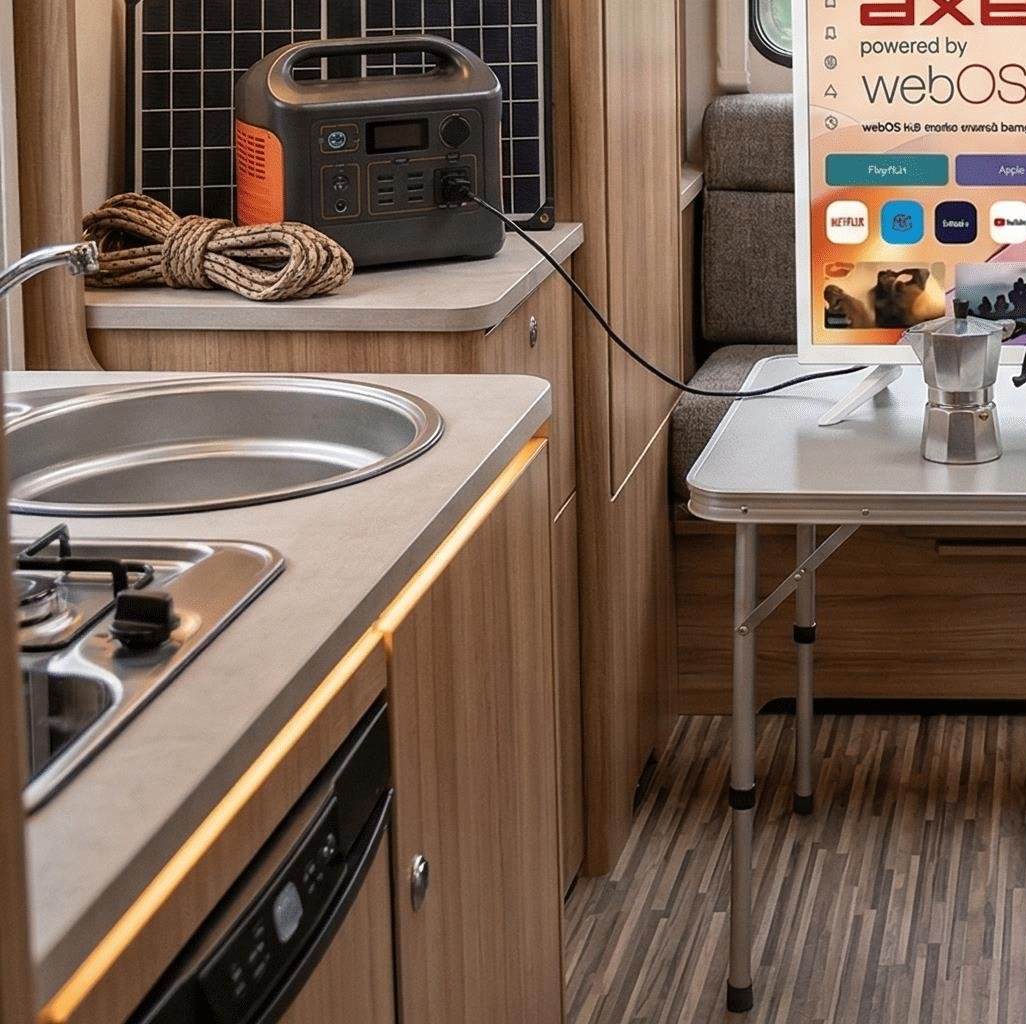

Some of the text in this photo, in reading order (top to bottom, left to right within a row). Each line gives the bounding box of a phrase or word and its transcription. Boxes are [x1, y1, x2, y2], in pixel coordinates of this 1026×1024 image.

[860, 37, 968, 57] powered by
[862, 122, 901, 133] webOS
